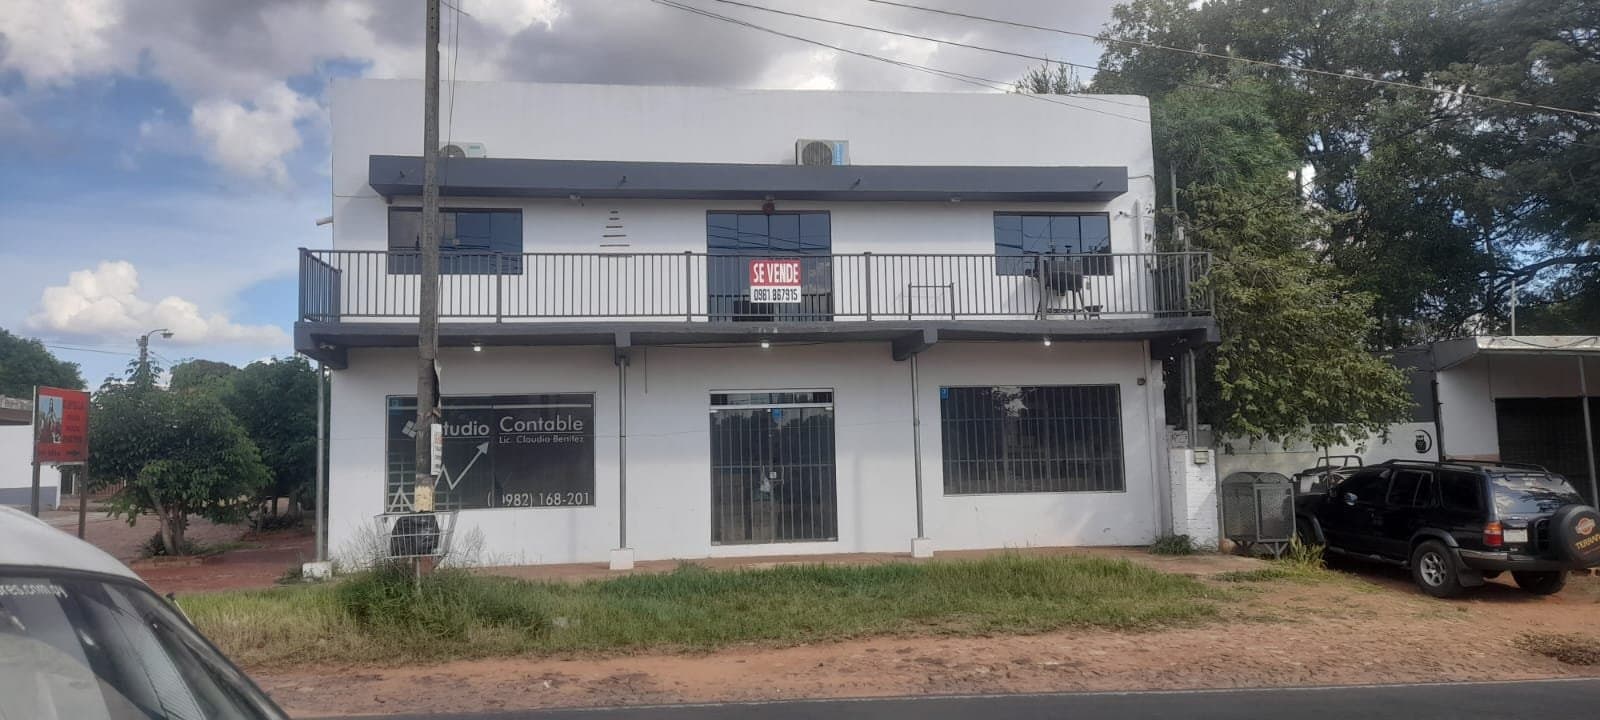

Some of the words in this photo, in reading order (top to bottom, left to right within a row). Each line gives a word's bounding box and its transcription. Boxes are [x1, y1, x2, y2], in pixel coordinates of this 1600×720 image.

[753, 263, 765, 283] SE
[766, 263, 799, 283] VENDE
[753, 288, 771, 301] 0981
[442, 419, 490, 437] tudio
[499, 413, 584, 432] Contable
[538, 492, 589, 506] 168-201
